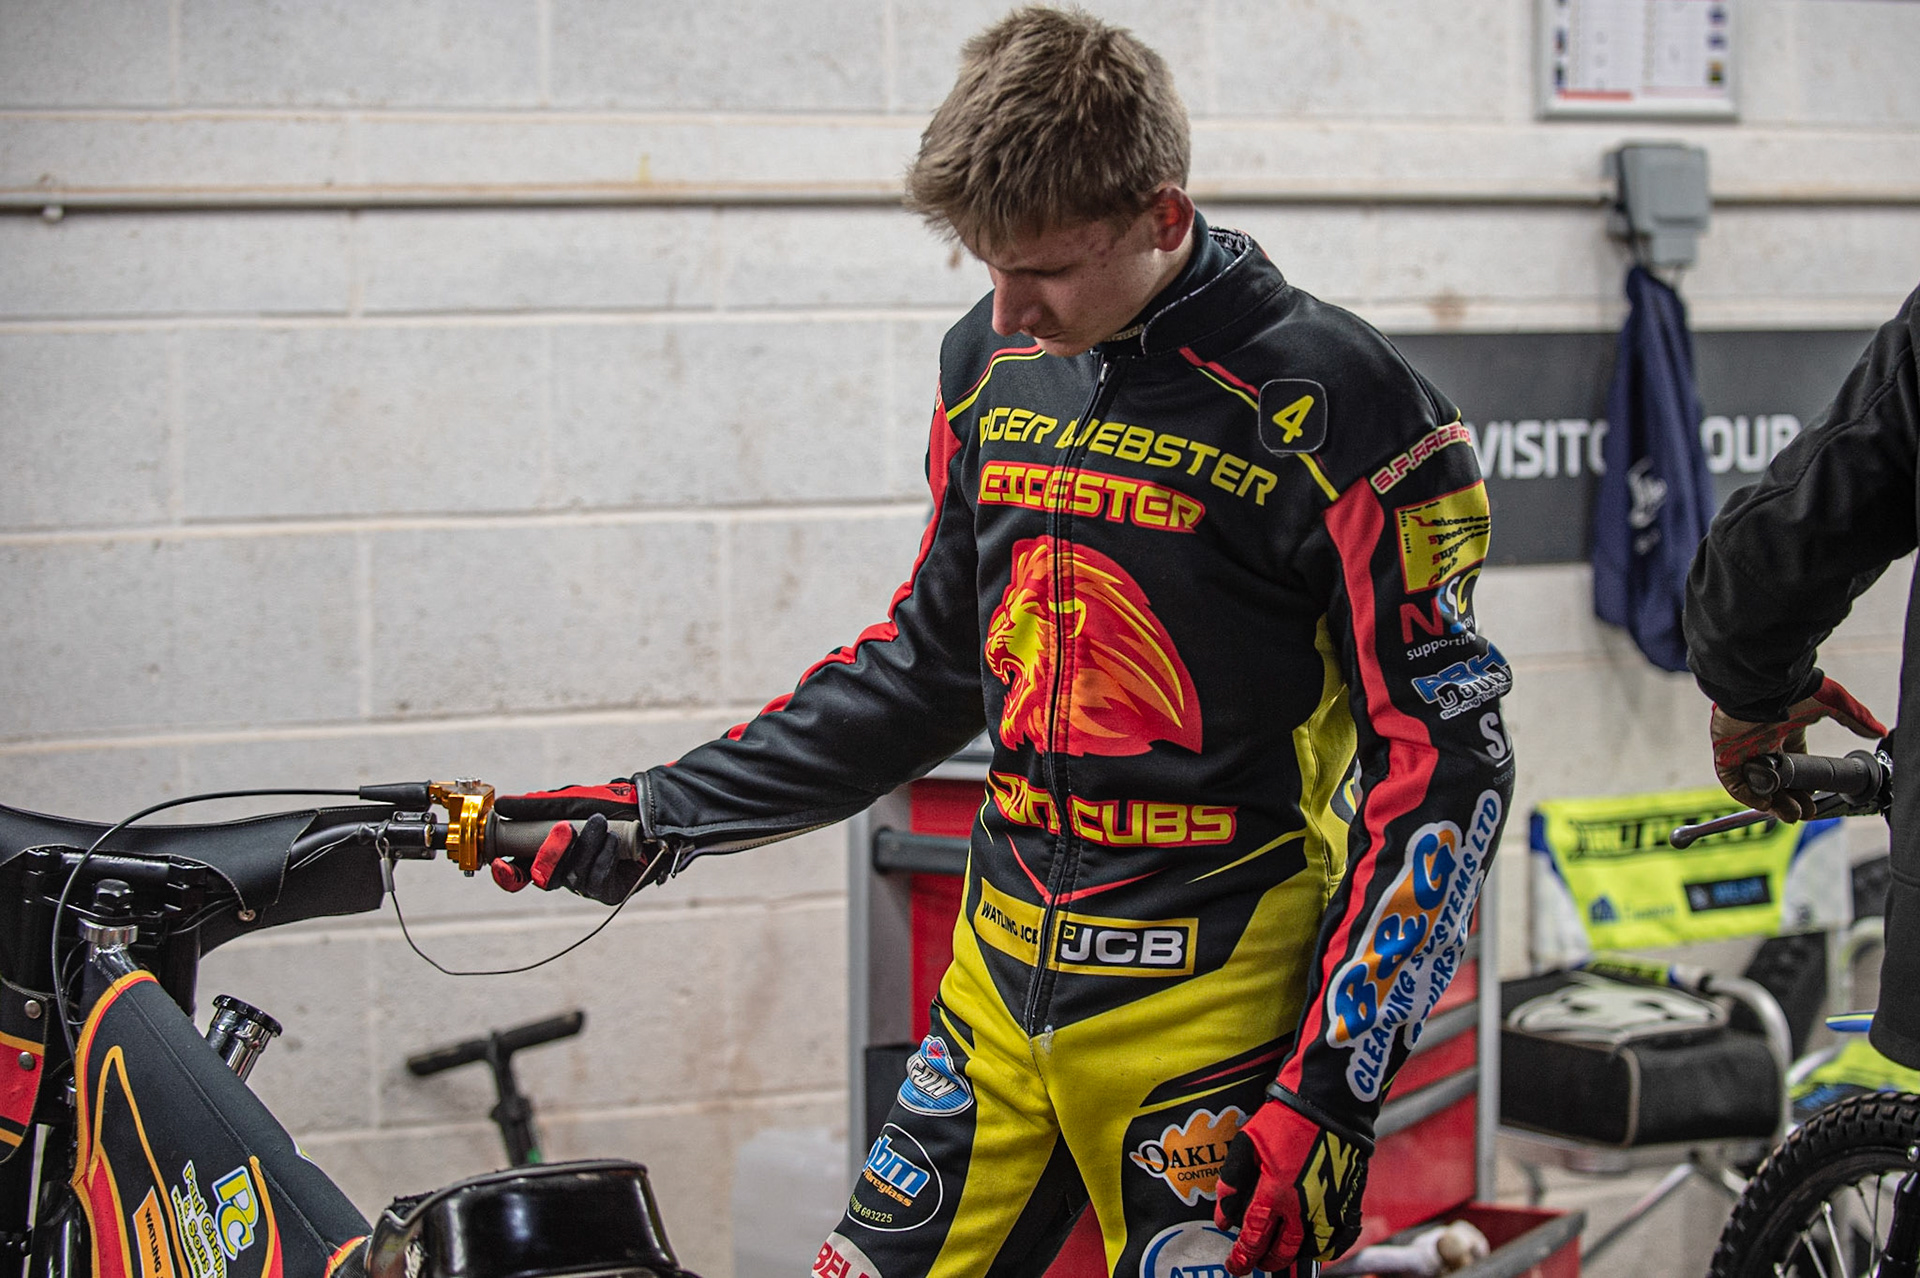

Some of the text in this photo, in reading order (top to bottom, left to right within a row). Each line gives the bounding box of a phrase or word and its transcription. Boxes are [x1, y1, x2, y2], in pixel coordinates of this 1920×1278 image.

[1272, 395, 1314, 443] 4
[1054, 416, 1278, 506] WEBSTER
[1463, 414, 1801, 479] VISITO OUR
[980, 464, 1203, 531] EICESTER
[994, 772, 1237, 844] ION CUBS
[981, 900, 1018, 938] WATLING
[1354, 797, 1498, 1094] CLEANING SYSTEMS LTD
[1060, 928, 1183, 965] JCB
[1141, 1140, 1233, 1175] OAKL
[1177, 1165, 1223, 1182] CONTRA
[184, 1164, 206, 1217] Paul
[860, 1206, 893, 1223] 693225
[145, 1207, 162, 1274] WATLING
[188, 1218, 210, 1274] Sons
[813, 1241, 870, 1278] BEL
